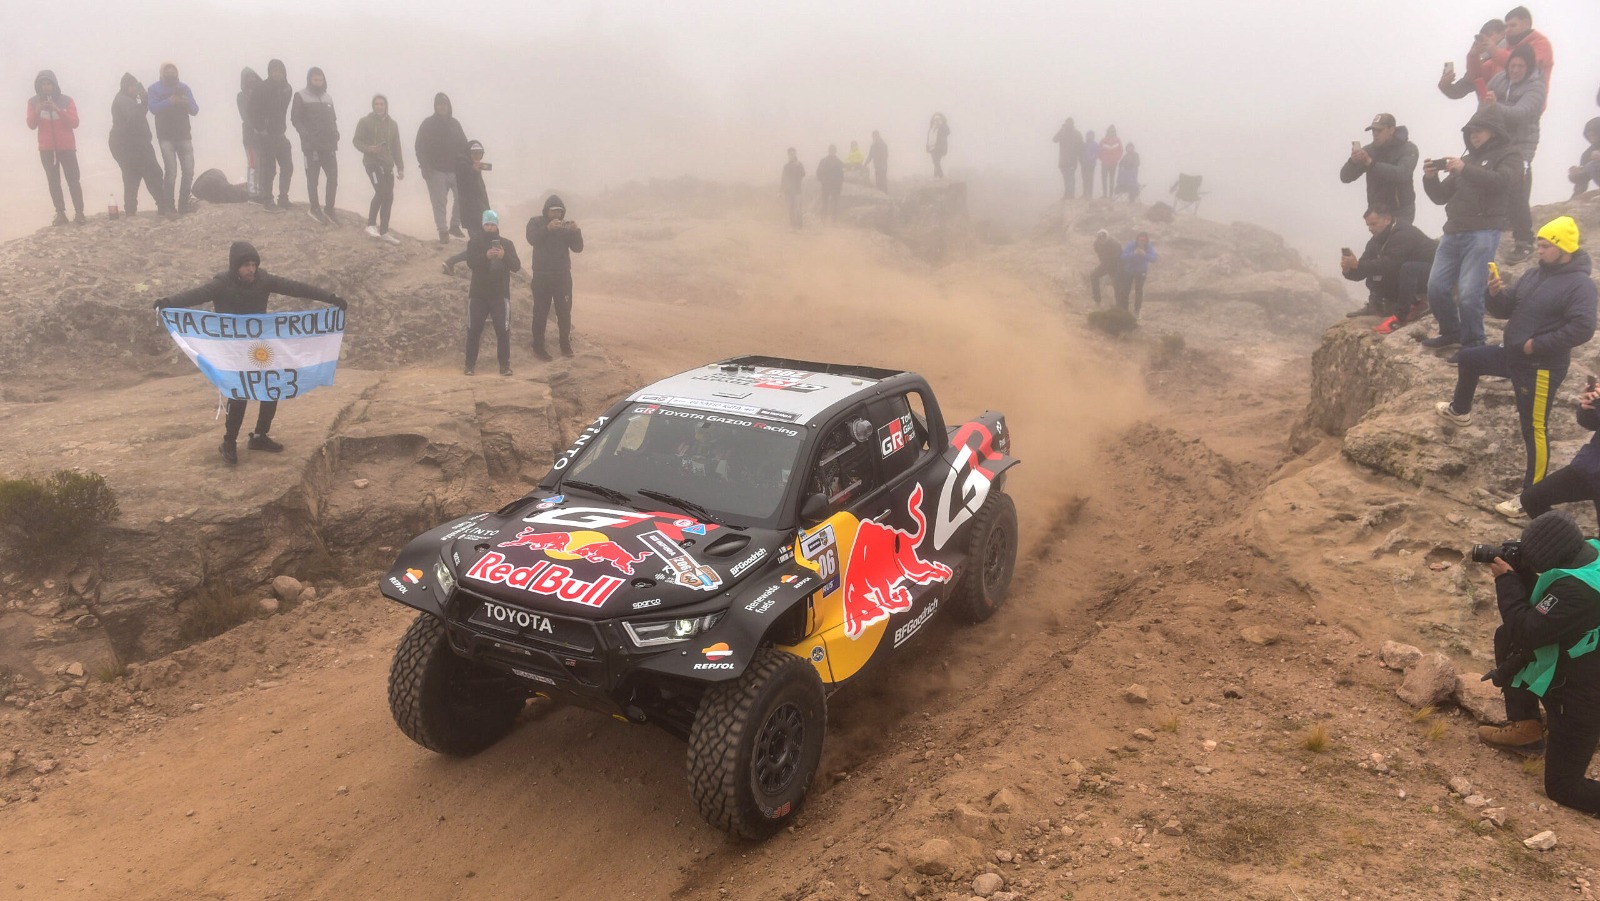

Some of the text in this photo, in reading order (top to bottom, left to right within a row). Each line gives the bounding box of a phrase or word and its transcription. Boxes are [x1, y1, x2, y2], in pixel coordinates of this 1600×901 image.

[162, 311, 263, 339] HACELO
[634, 405, 798, 437] GR TOYOTA GAZOO Racing
[881, 430, 905, 456] GR
[730, 547, 767, 576] BFGoodrich
[389, 576, 409, 595] REPSOL
[793, 577, 812, 589] REPSOL
[633, 598, 661, 609] sparco
[745, 585, 780, 611] Renewable
[755, 600, 775, 614] fuels
[484, 602, 553, 634] TOYOTA
[894, 598, 938, 643] BFGoodrich
